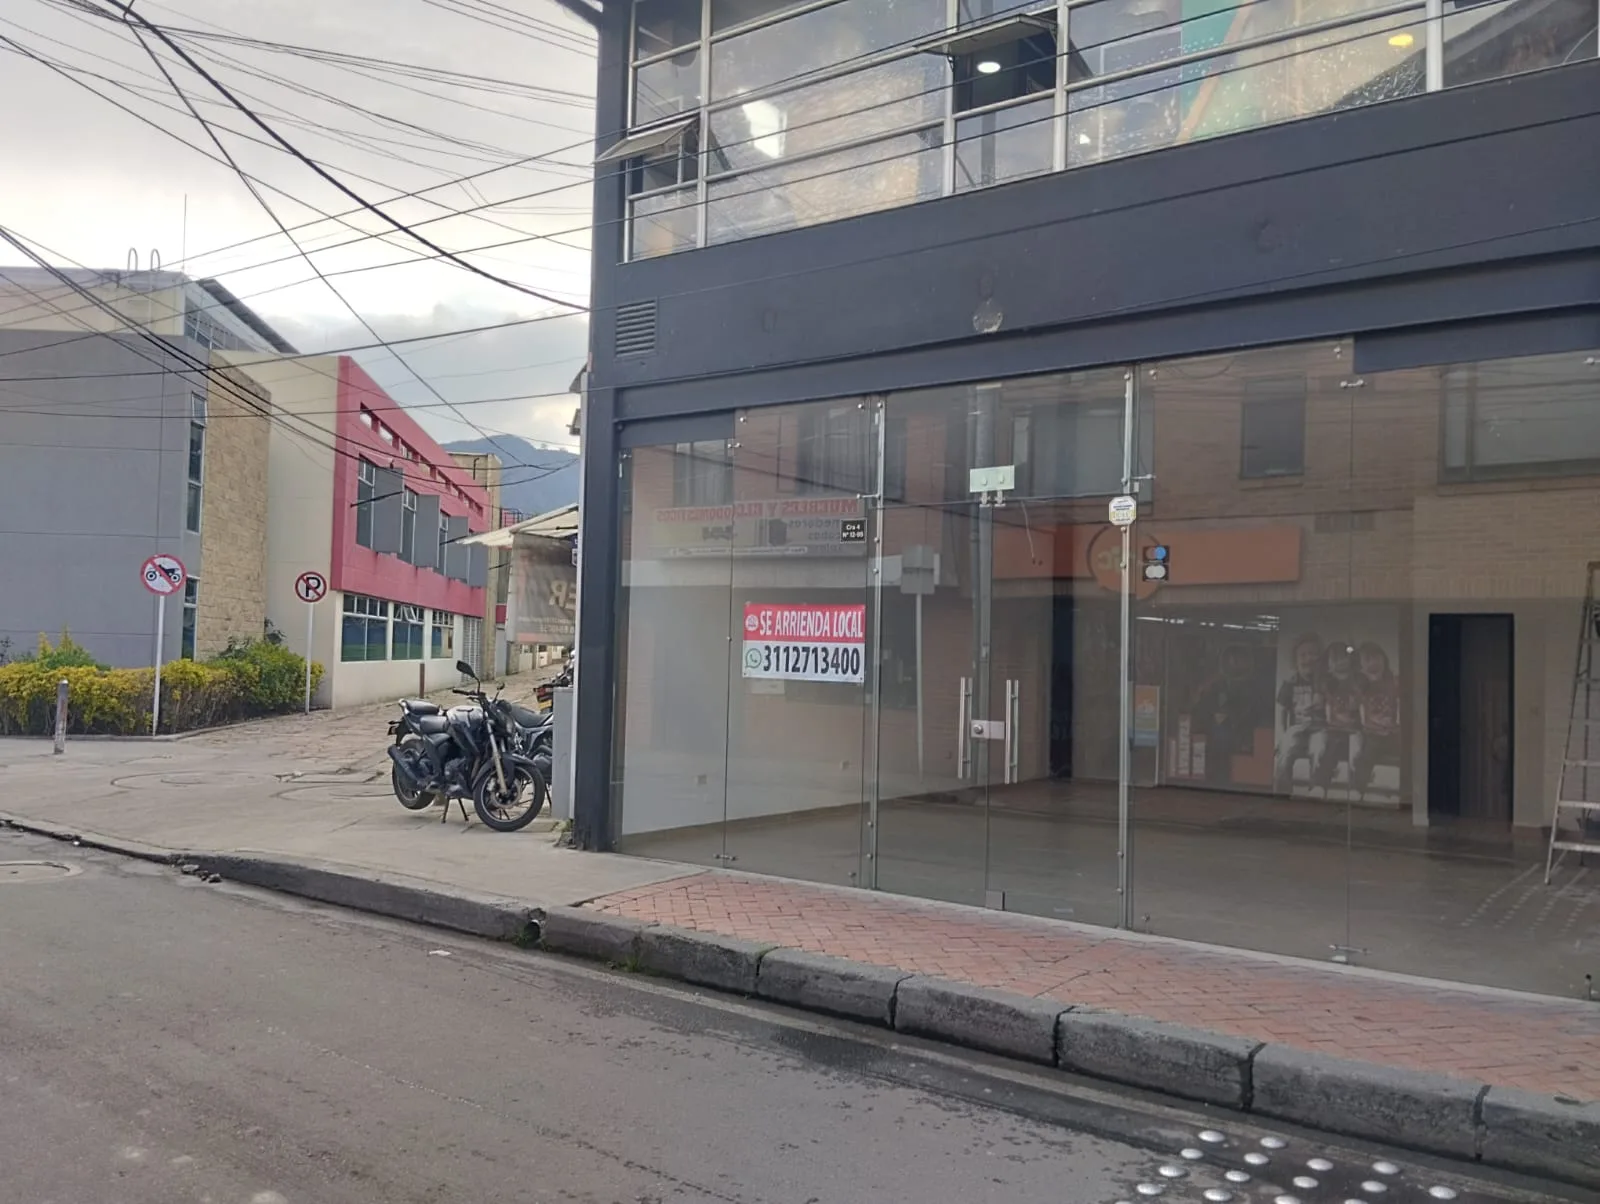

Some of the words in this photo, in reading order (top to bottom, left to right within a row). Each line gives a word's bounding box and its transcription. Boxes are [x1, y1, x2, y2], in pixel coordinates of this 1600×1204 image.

[306, 577, 321, 597] P
[760, 610, 773, 635] SE
[775, 611, 830, 637] ARRIENDA
[833, 611, 863, 638] LOCAL
[763, 645, 860, 675] 3112713400
